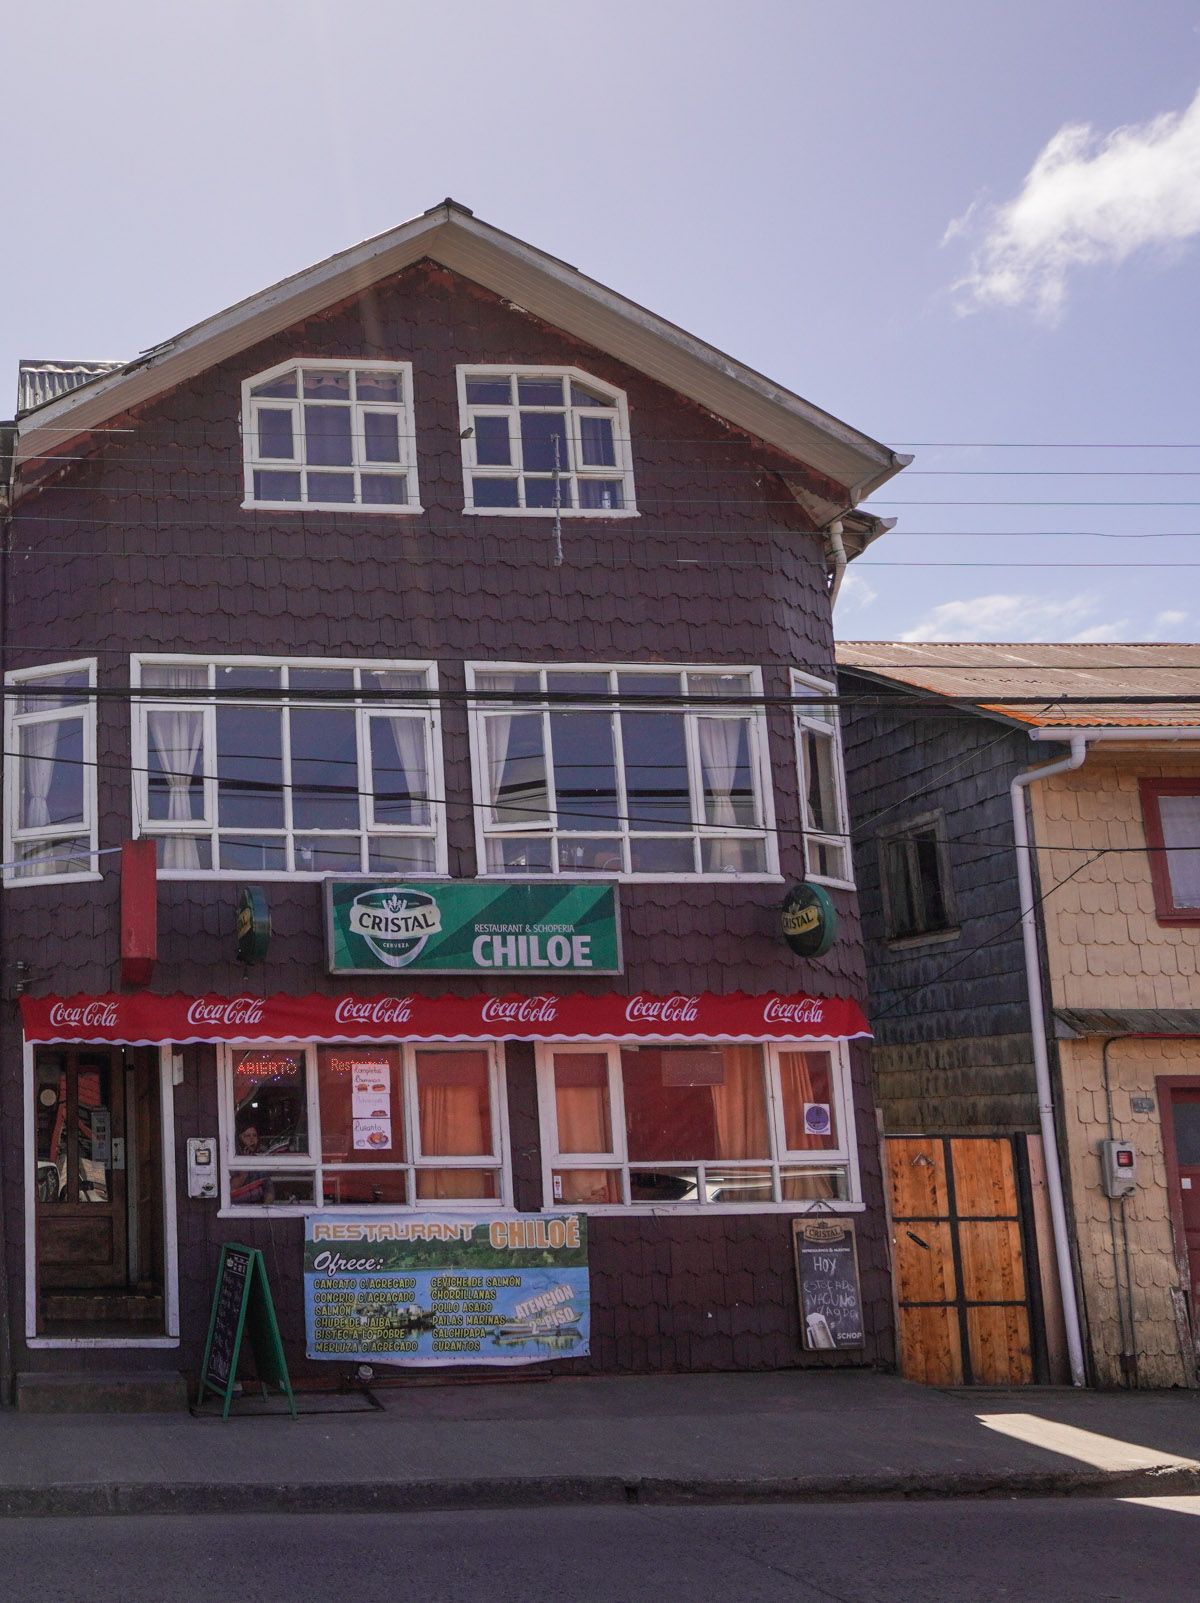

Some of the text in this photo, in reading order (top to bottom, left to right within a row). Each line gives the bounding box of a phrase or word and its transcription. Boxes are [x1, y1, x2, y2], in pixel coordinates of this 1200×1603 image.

[358, 912, 436, 933] CRISTAL
[474, 923, 575, 933] RESTAURANT & SCHOPERIA
[472, 934, 593, 967] CHILOE
[236, 1061, 297, 1075] ABIERTO
[313, 1216, 581, 1249] RESTAURANT CHILOÉ
[809, 1229, 841, 1238] CRISTAL
[313, 1251, 385, 1276] Ofrece:
[813, 1256, 837, 1276] HOY
[314, 1279, 357, 1289] CANCATO
[431, 1275, 521, 1287] CEVICHE DE SALMÓN
[314, 1292, 355, 1303] CONGRIO
[431, 1289, 496, 1300] CHORRILLANAS
[315, 1304, 352, 1316] SALMÓN
[432, 1302, 493, 1313] POLLO ASADO
[315, 1317, 391, 1328] CHUPE DE JAIBA
[432, 1314, 506, 1326] PAILAS MARINAS
[544, 1306, 575, 1328] PISO
[315, 1328, 406, 1340] BISTEC A LO POBRE
[432, 1328, 487, 1339] SALCHIPAPA
[836, 1332, 862, 1340] SCHOP
[315, 1342, 359, 1353] MERLUZA
[432, 1341, 480, 1352] CURANTOS
